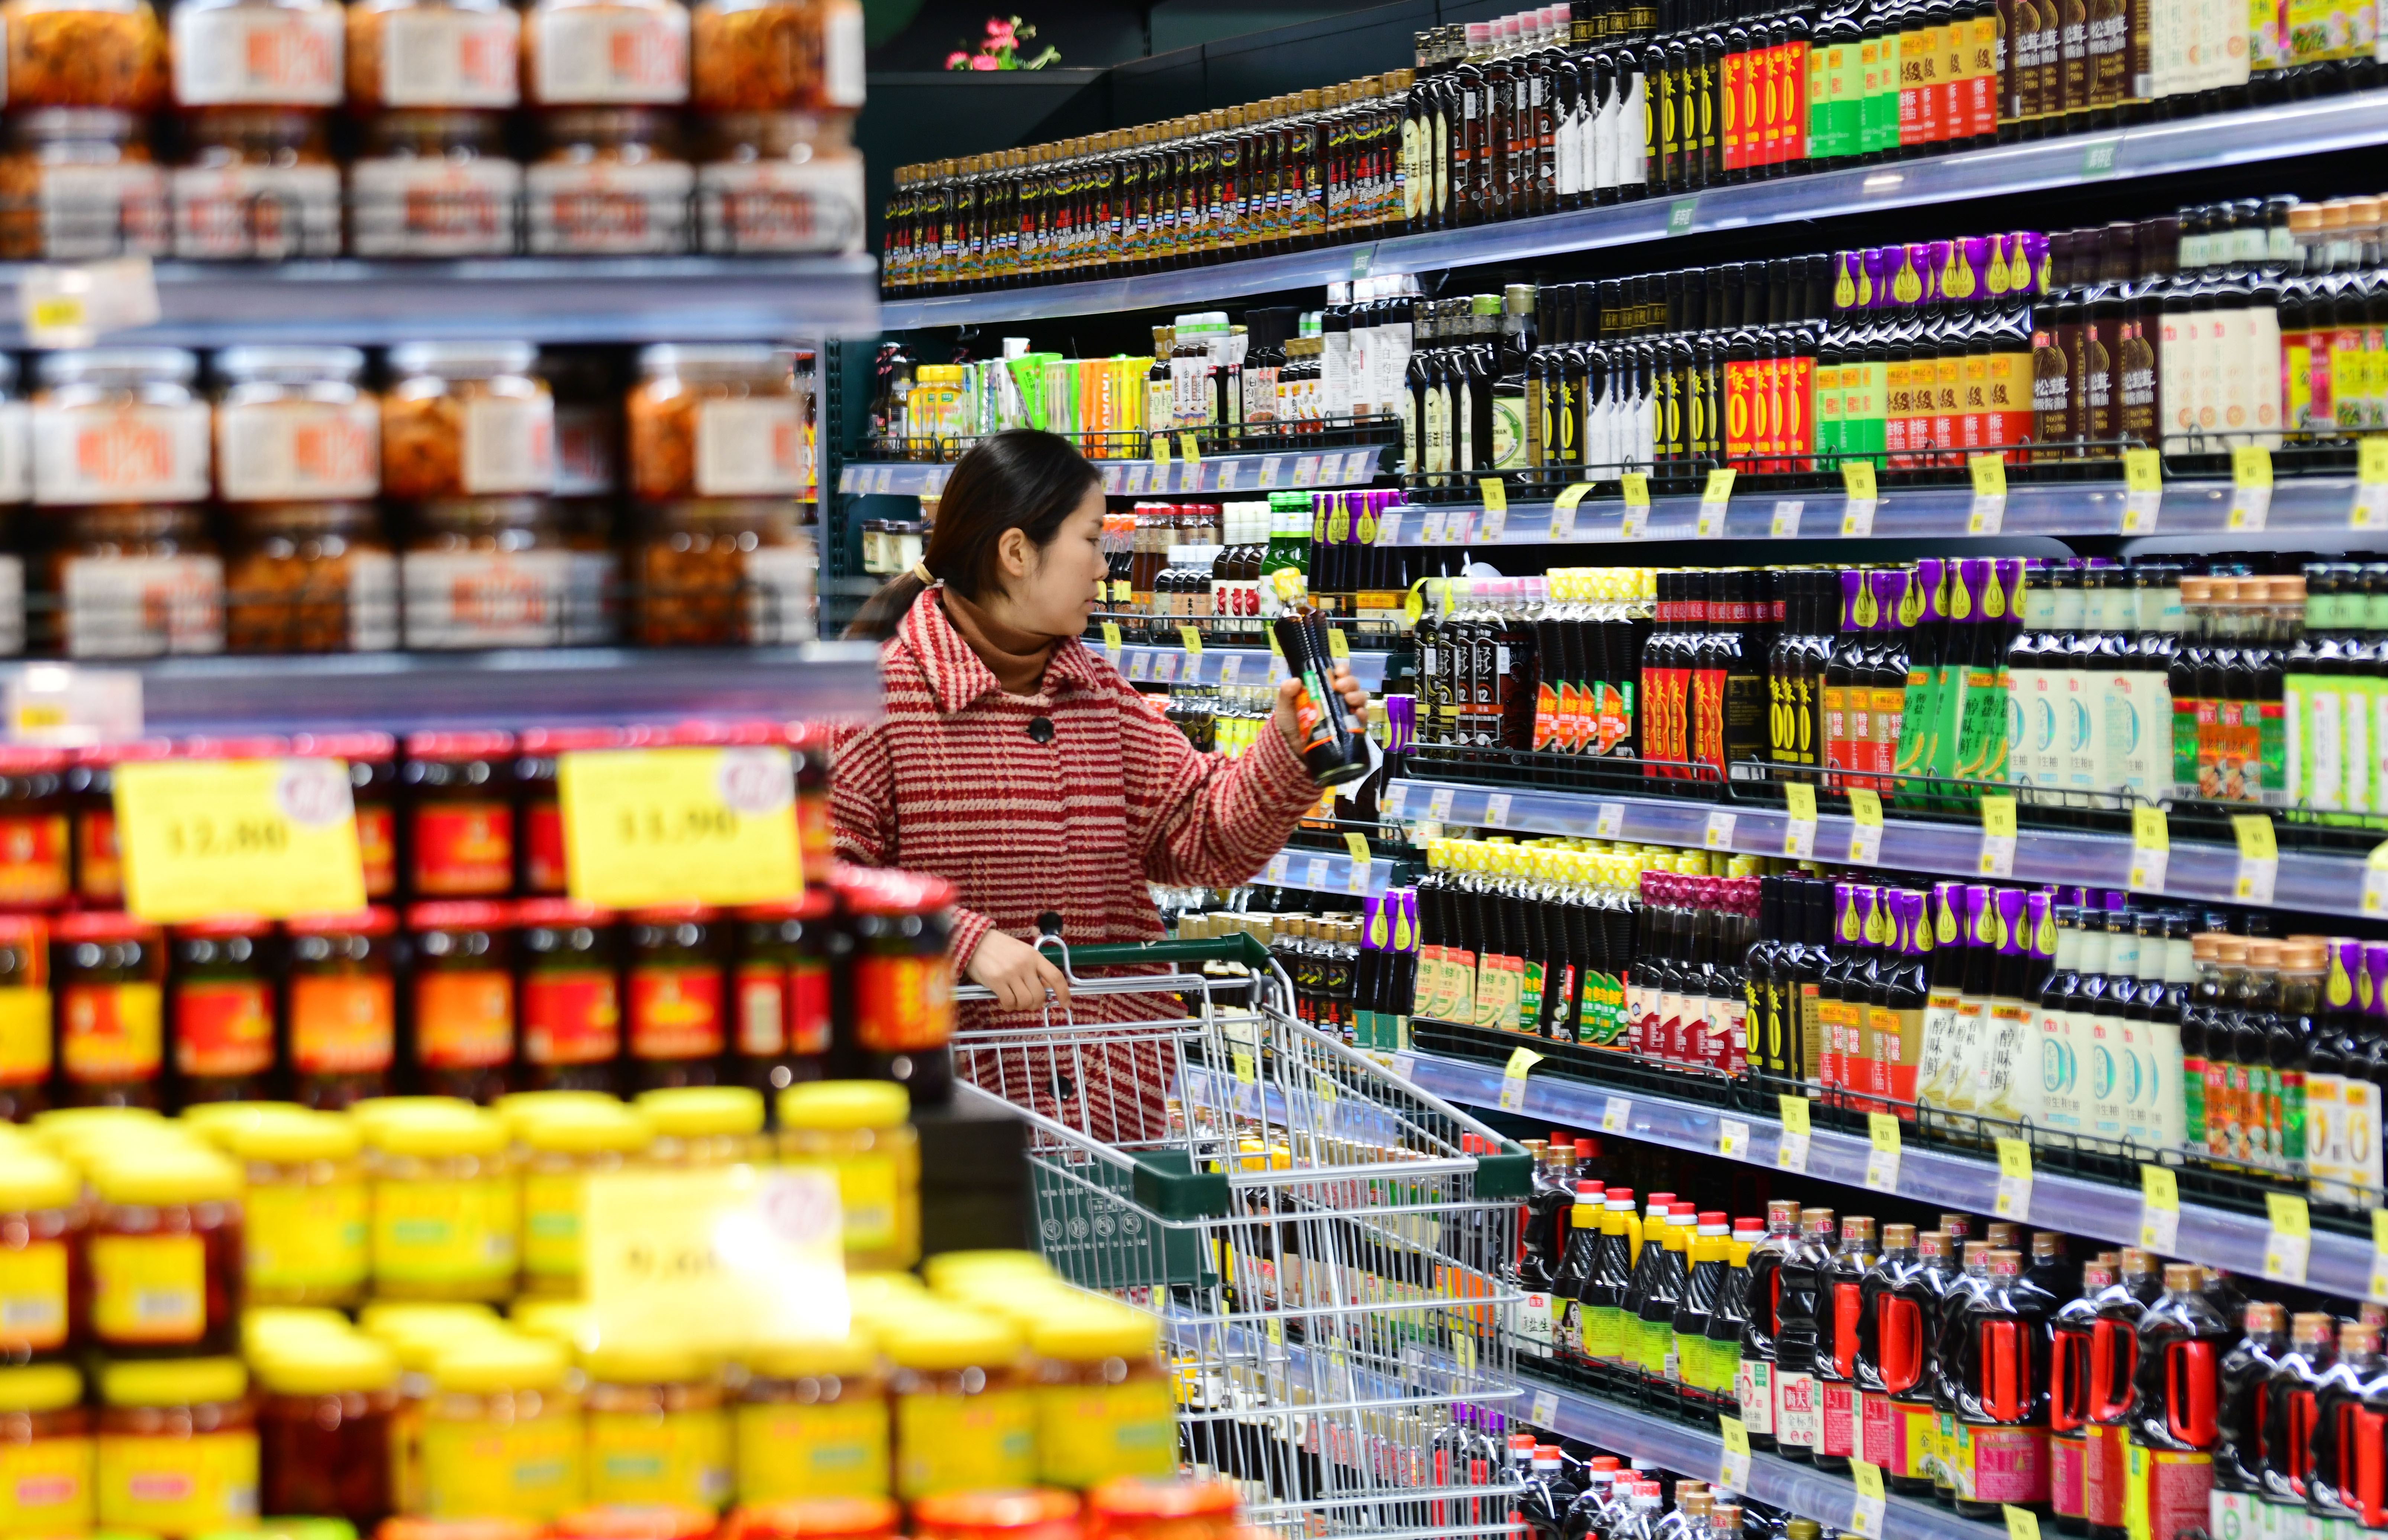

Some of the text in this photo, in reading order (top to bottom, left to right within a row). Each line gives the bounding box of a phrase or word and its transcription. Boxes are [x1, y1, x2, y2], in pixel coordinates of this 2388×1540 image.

[1900, 61, 1924, 84] 级
[1888, 390, 1910, 413] 级
[1911, 389, 1935, 411] 级
[1834, 713, 1843, 736] 特级
[1859, 713, 1868, 736] 特级
[1960, 698, 1978, 757] 醇味鲜
[1878, 714, 1890, 772] 精选生抽
[2010, 755, 2028, 766] 生抽
[1850, 1029, 1859, 1053] 特级
[1967, 1020, 1978, 1045] 有机
[1891, 1036, 1900, 1061] 特级
[1927, 1017, 1948, 1077] 醇味鲜
[1994, 1028, 2015, 1091] 醇味鲜
[1921, 1434, 1930, 1447] 金
